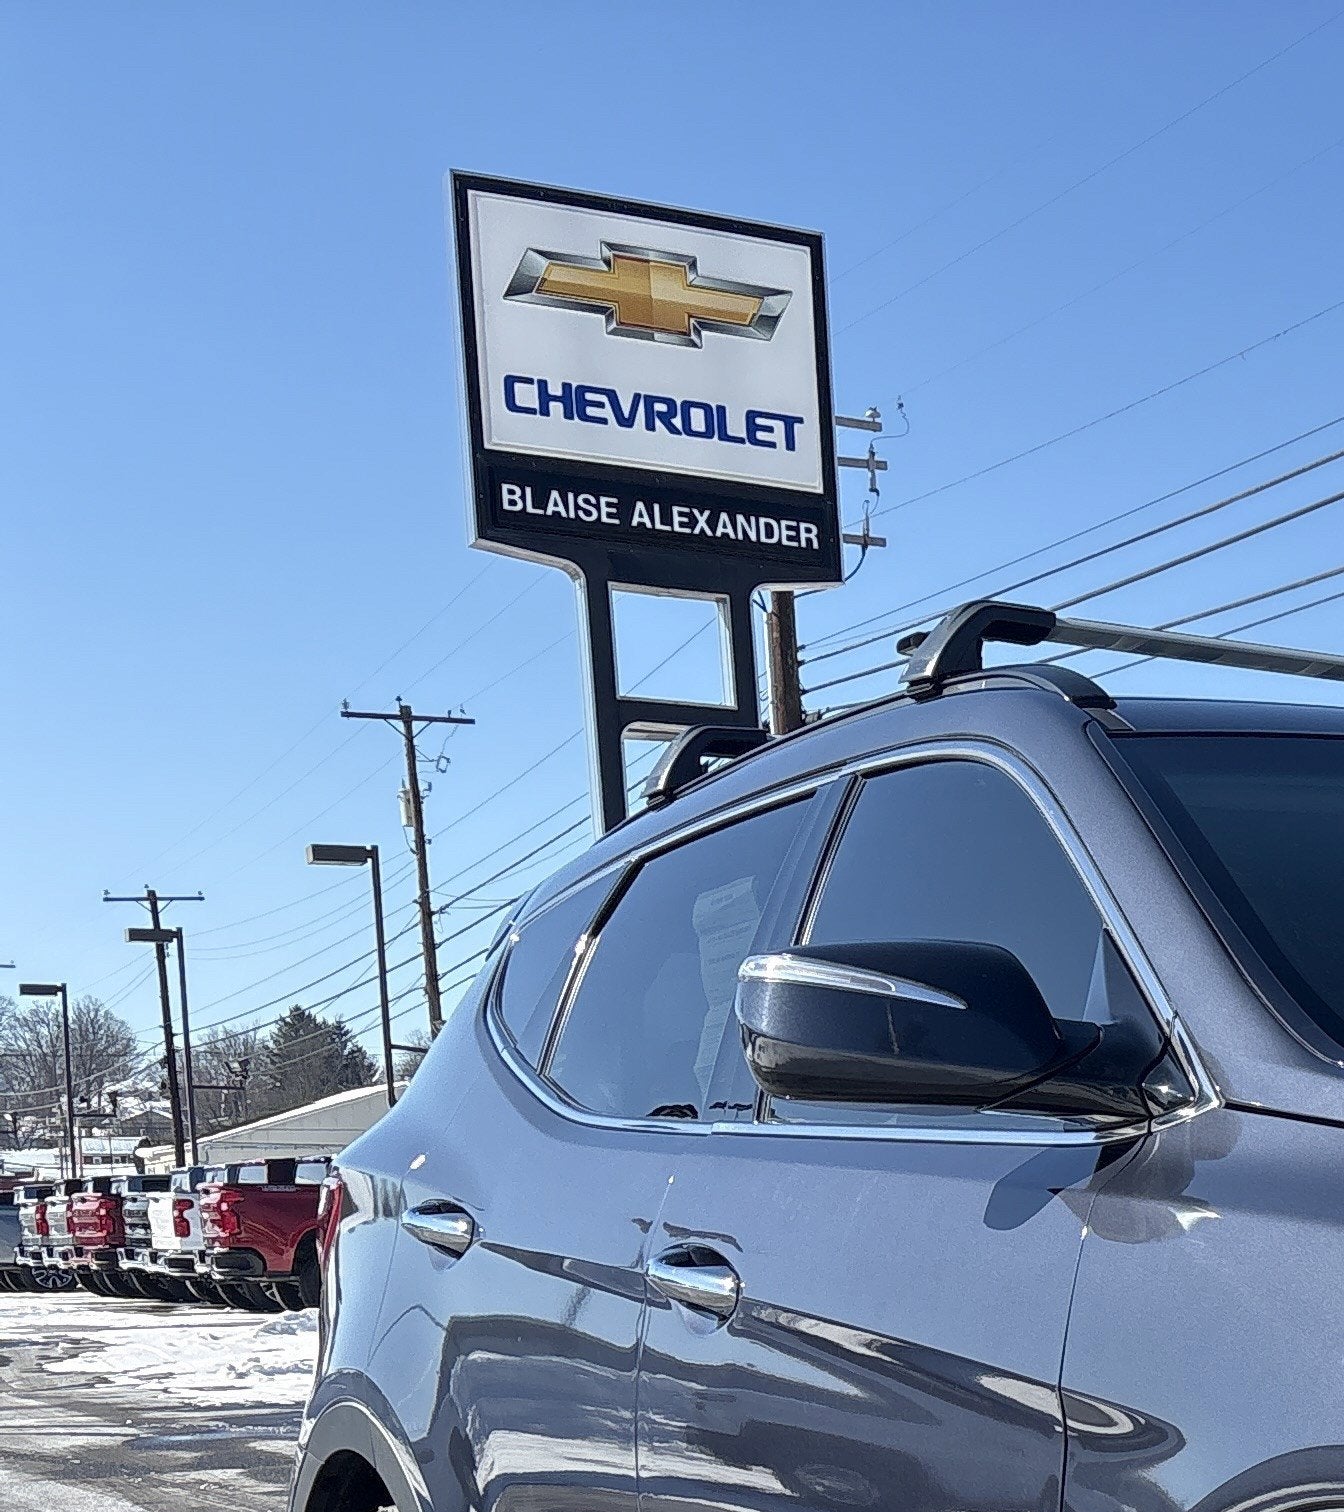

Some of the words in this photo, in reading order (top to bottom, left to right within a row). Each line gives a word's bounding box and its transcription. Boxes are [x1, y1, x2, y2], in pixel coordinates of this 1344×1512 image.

[503, 373, 804, 451] CHEVROLET
[501, 483, 620, 525] BLAISE
[630, 500, 820, 550] ALEXANDER
